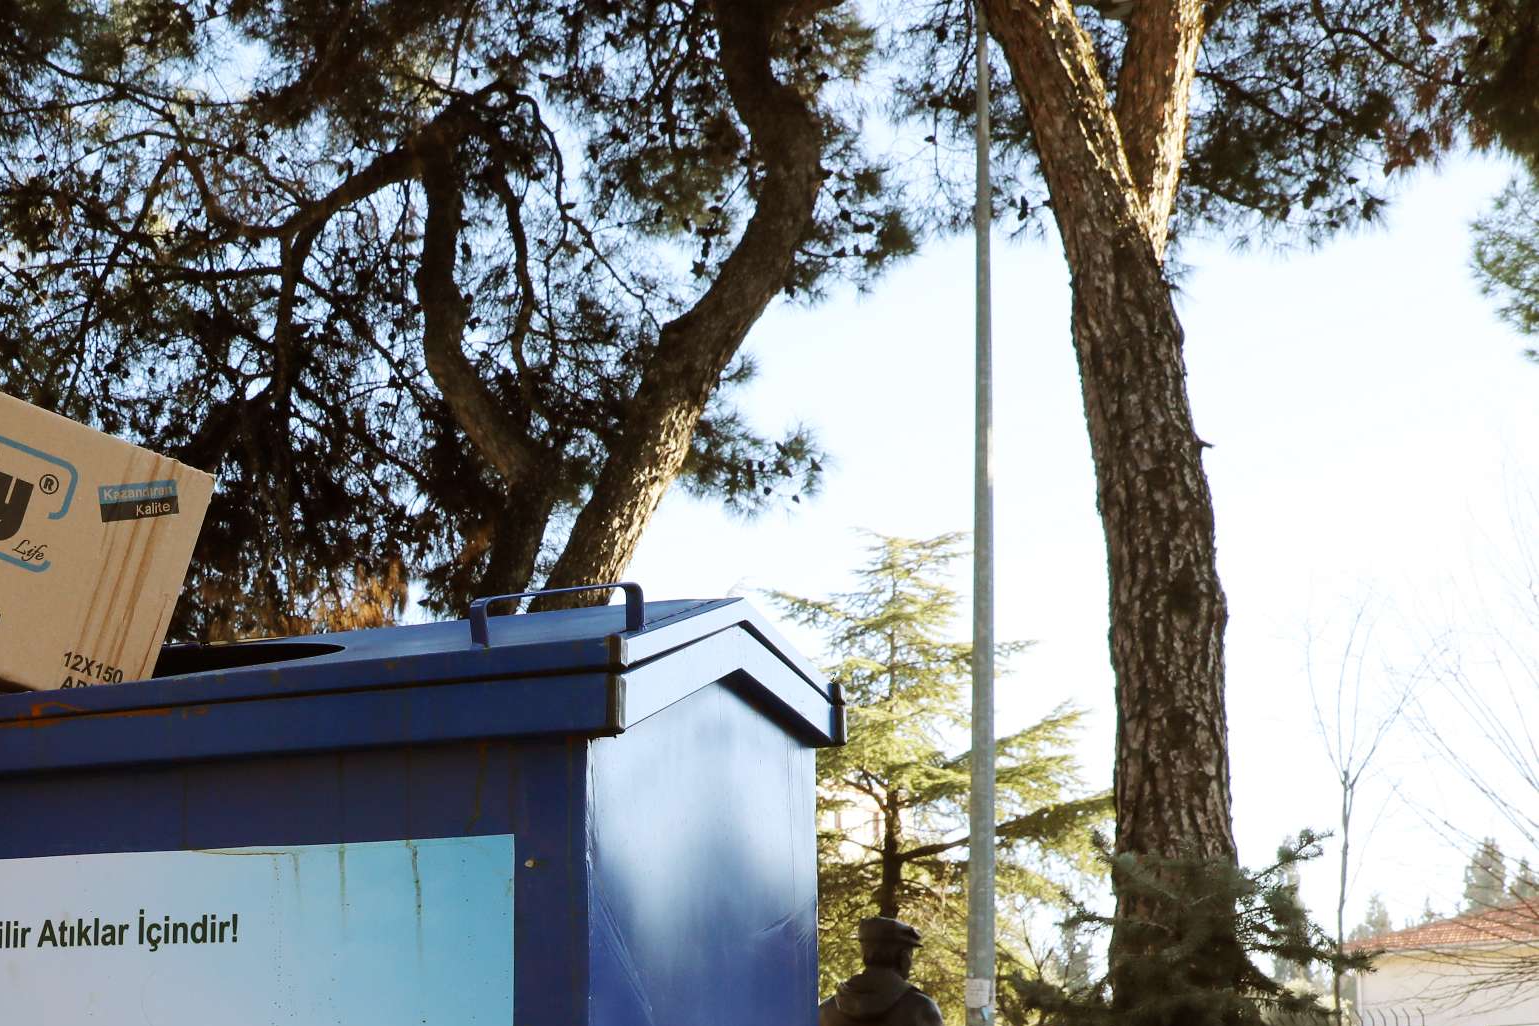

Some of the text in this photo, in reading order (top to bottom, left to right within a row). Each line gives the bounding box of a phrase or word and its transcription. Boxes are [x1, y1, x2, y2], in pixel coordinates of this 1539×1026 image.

[136, 501, 171, 517] Kalite
[11, 539, 48, 562] Life
[63, 651, 124, 684] 12X150
[37, 917, 130, 949] Atıklar
[138, 908, 239, 953] İçindir!
